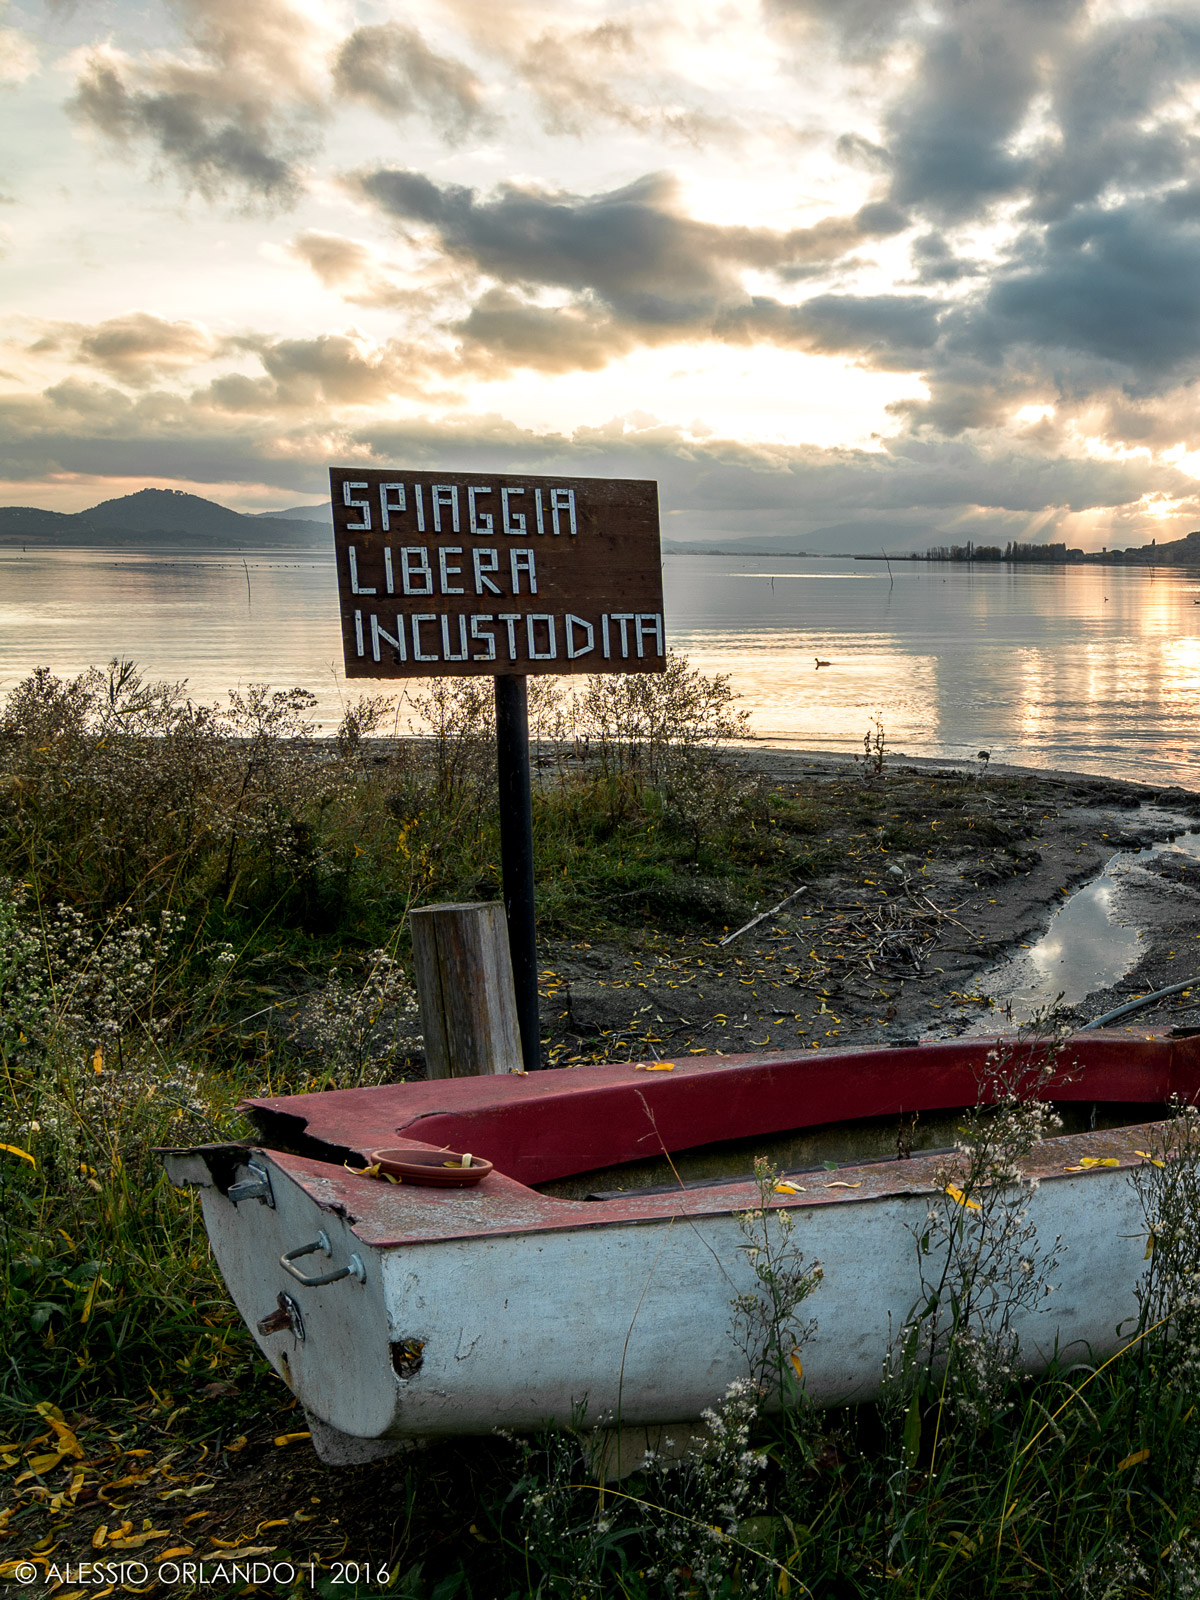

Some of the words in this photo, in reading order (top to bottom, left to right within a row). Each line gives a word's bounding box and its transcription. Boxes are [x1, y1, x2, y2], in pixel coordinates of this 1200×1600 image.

[342, 481, 578, 535] SPIAGGIA
[349, 545, 538, 595] LIBERA
[354, 609, 664, 662] INCUSTODITA
